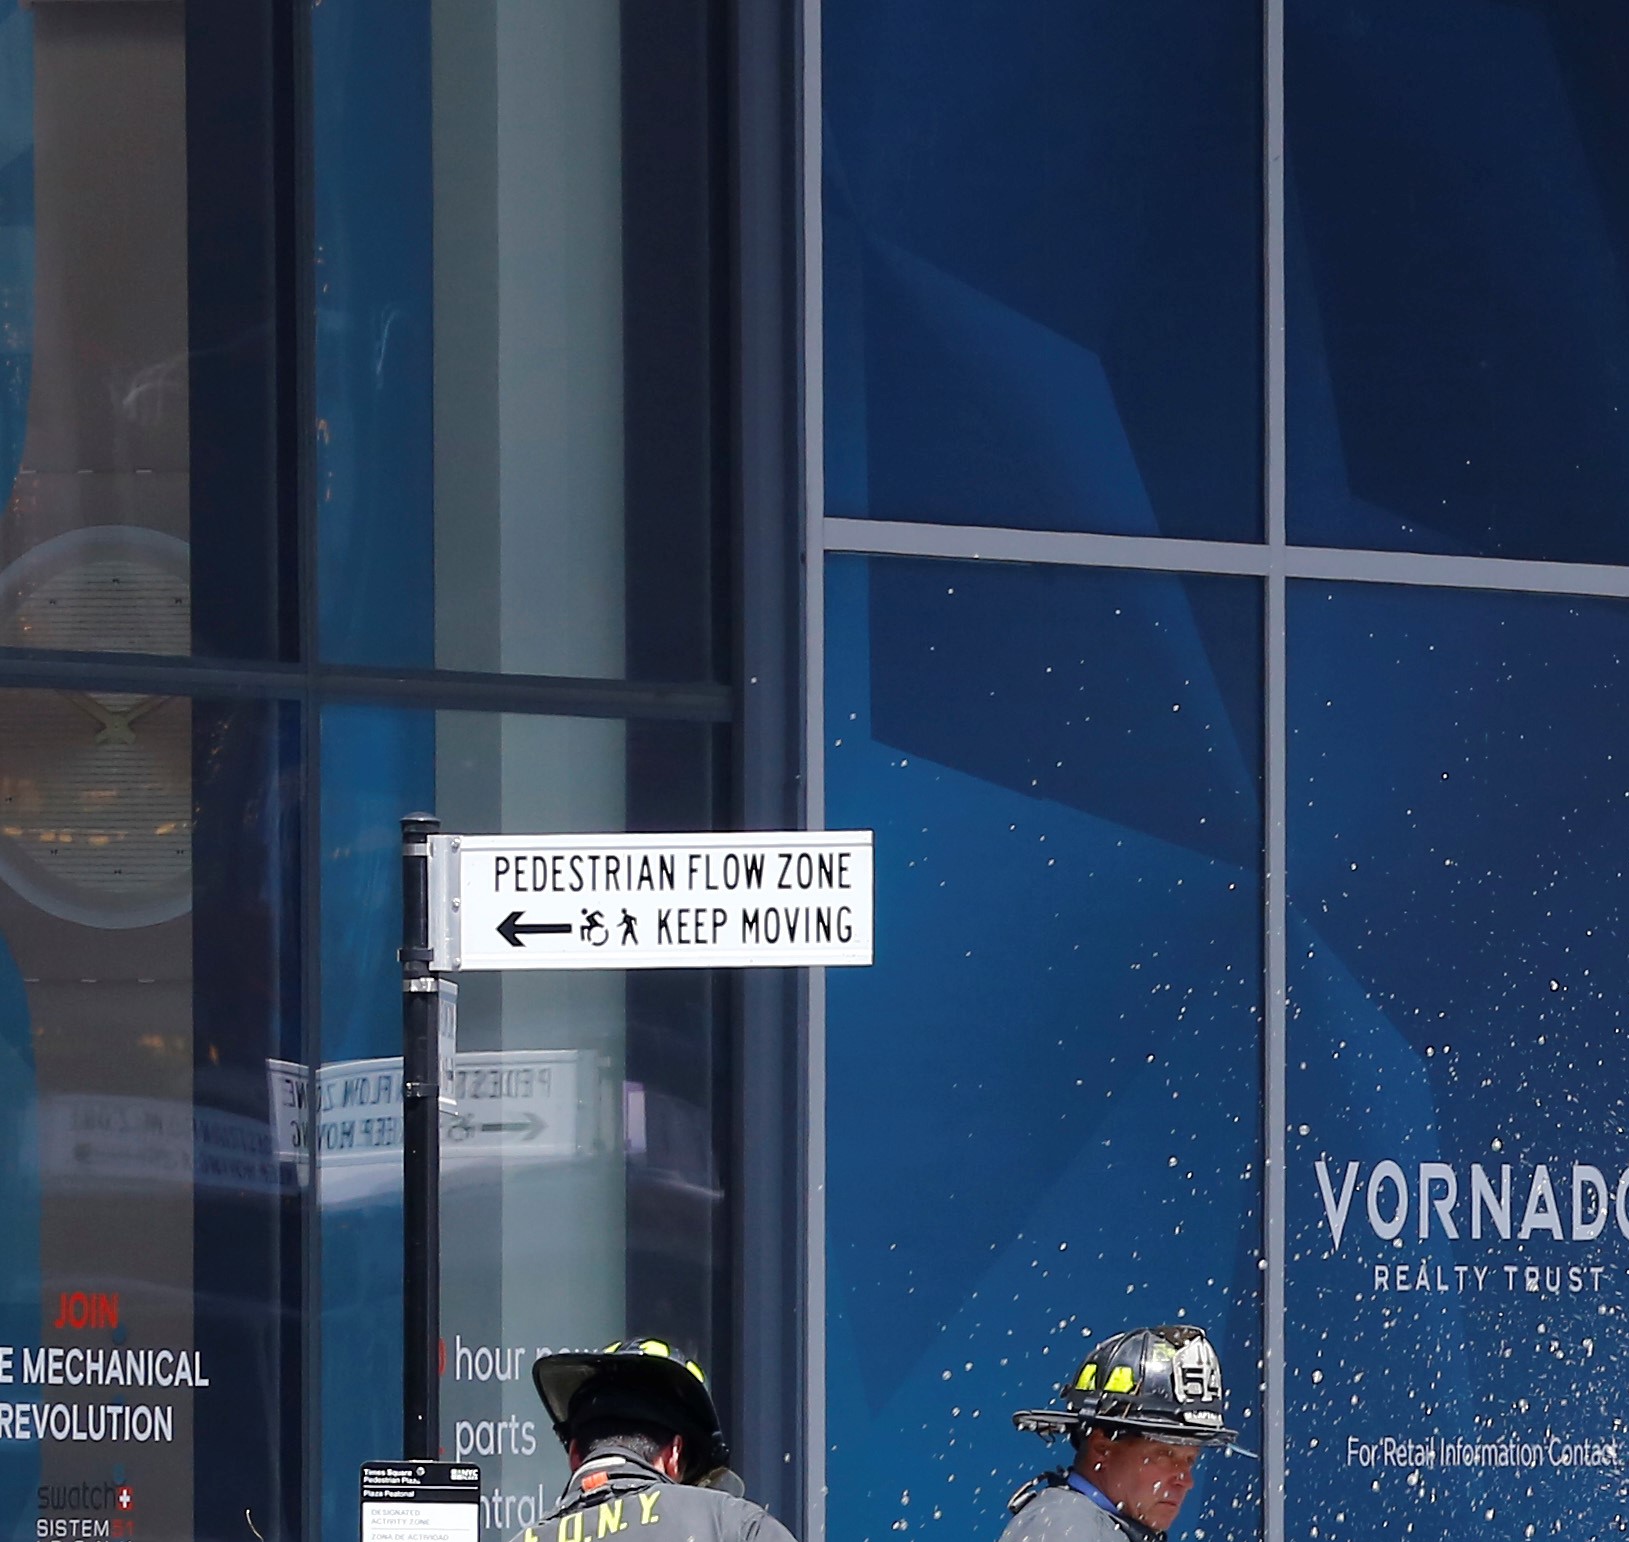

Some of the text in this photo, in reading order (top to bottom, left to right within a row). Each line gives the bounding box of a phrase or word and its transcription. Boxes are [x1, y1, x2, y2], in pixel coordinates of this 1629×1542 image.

[494, 852, 852, 893] PEDESTRIAN FLOW ZONE
[657, 906, 853, 946] KEEP MOVING
[1373, 1264, 1605, 1293] REALTY TRUST
[54, 1291, 120, 1329] JOIN
[22, 1347, 210, 1388] MECHANICAL
[455, 1334, 526, 1382] hour
[0, 1402, 173, 1442] REVOLUTION
[455, 1414, 537, 1463] parts
[1347, 1436, 1377, 1467] For
[1383, 1436, 1435, 1467] Retail
[1440, 1436, 1545, 1467] Information
[37, 1481, 116, 1511] swatch
